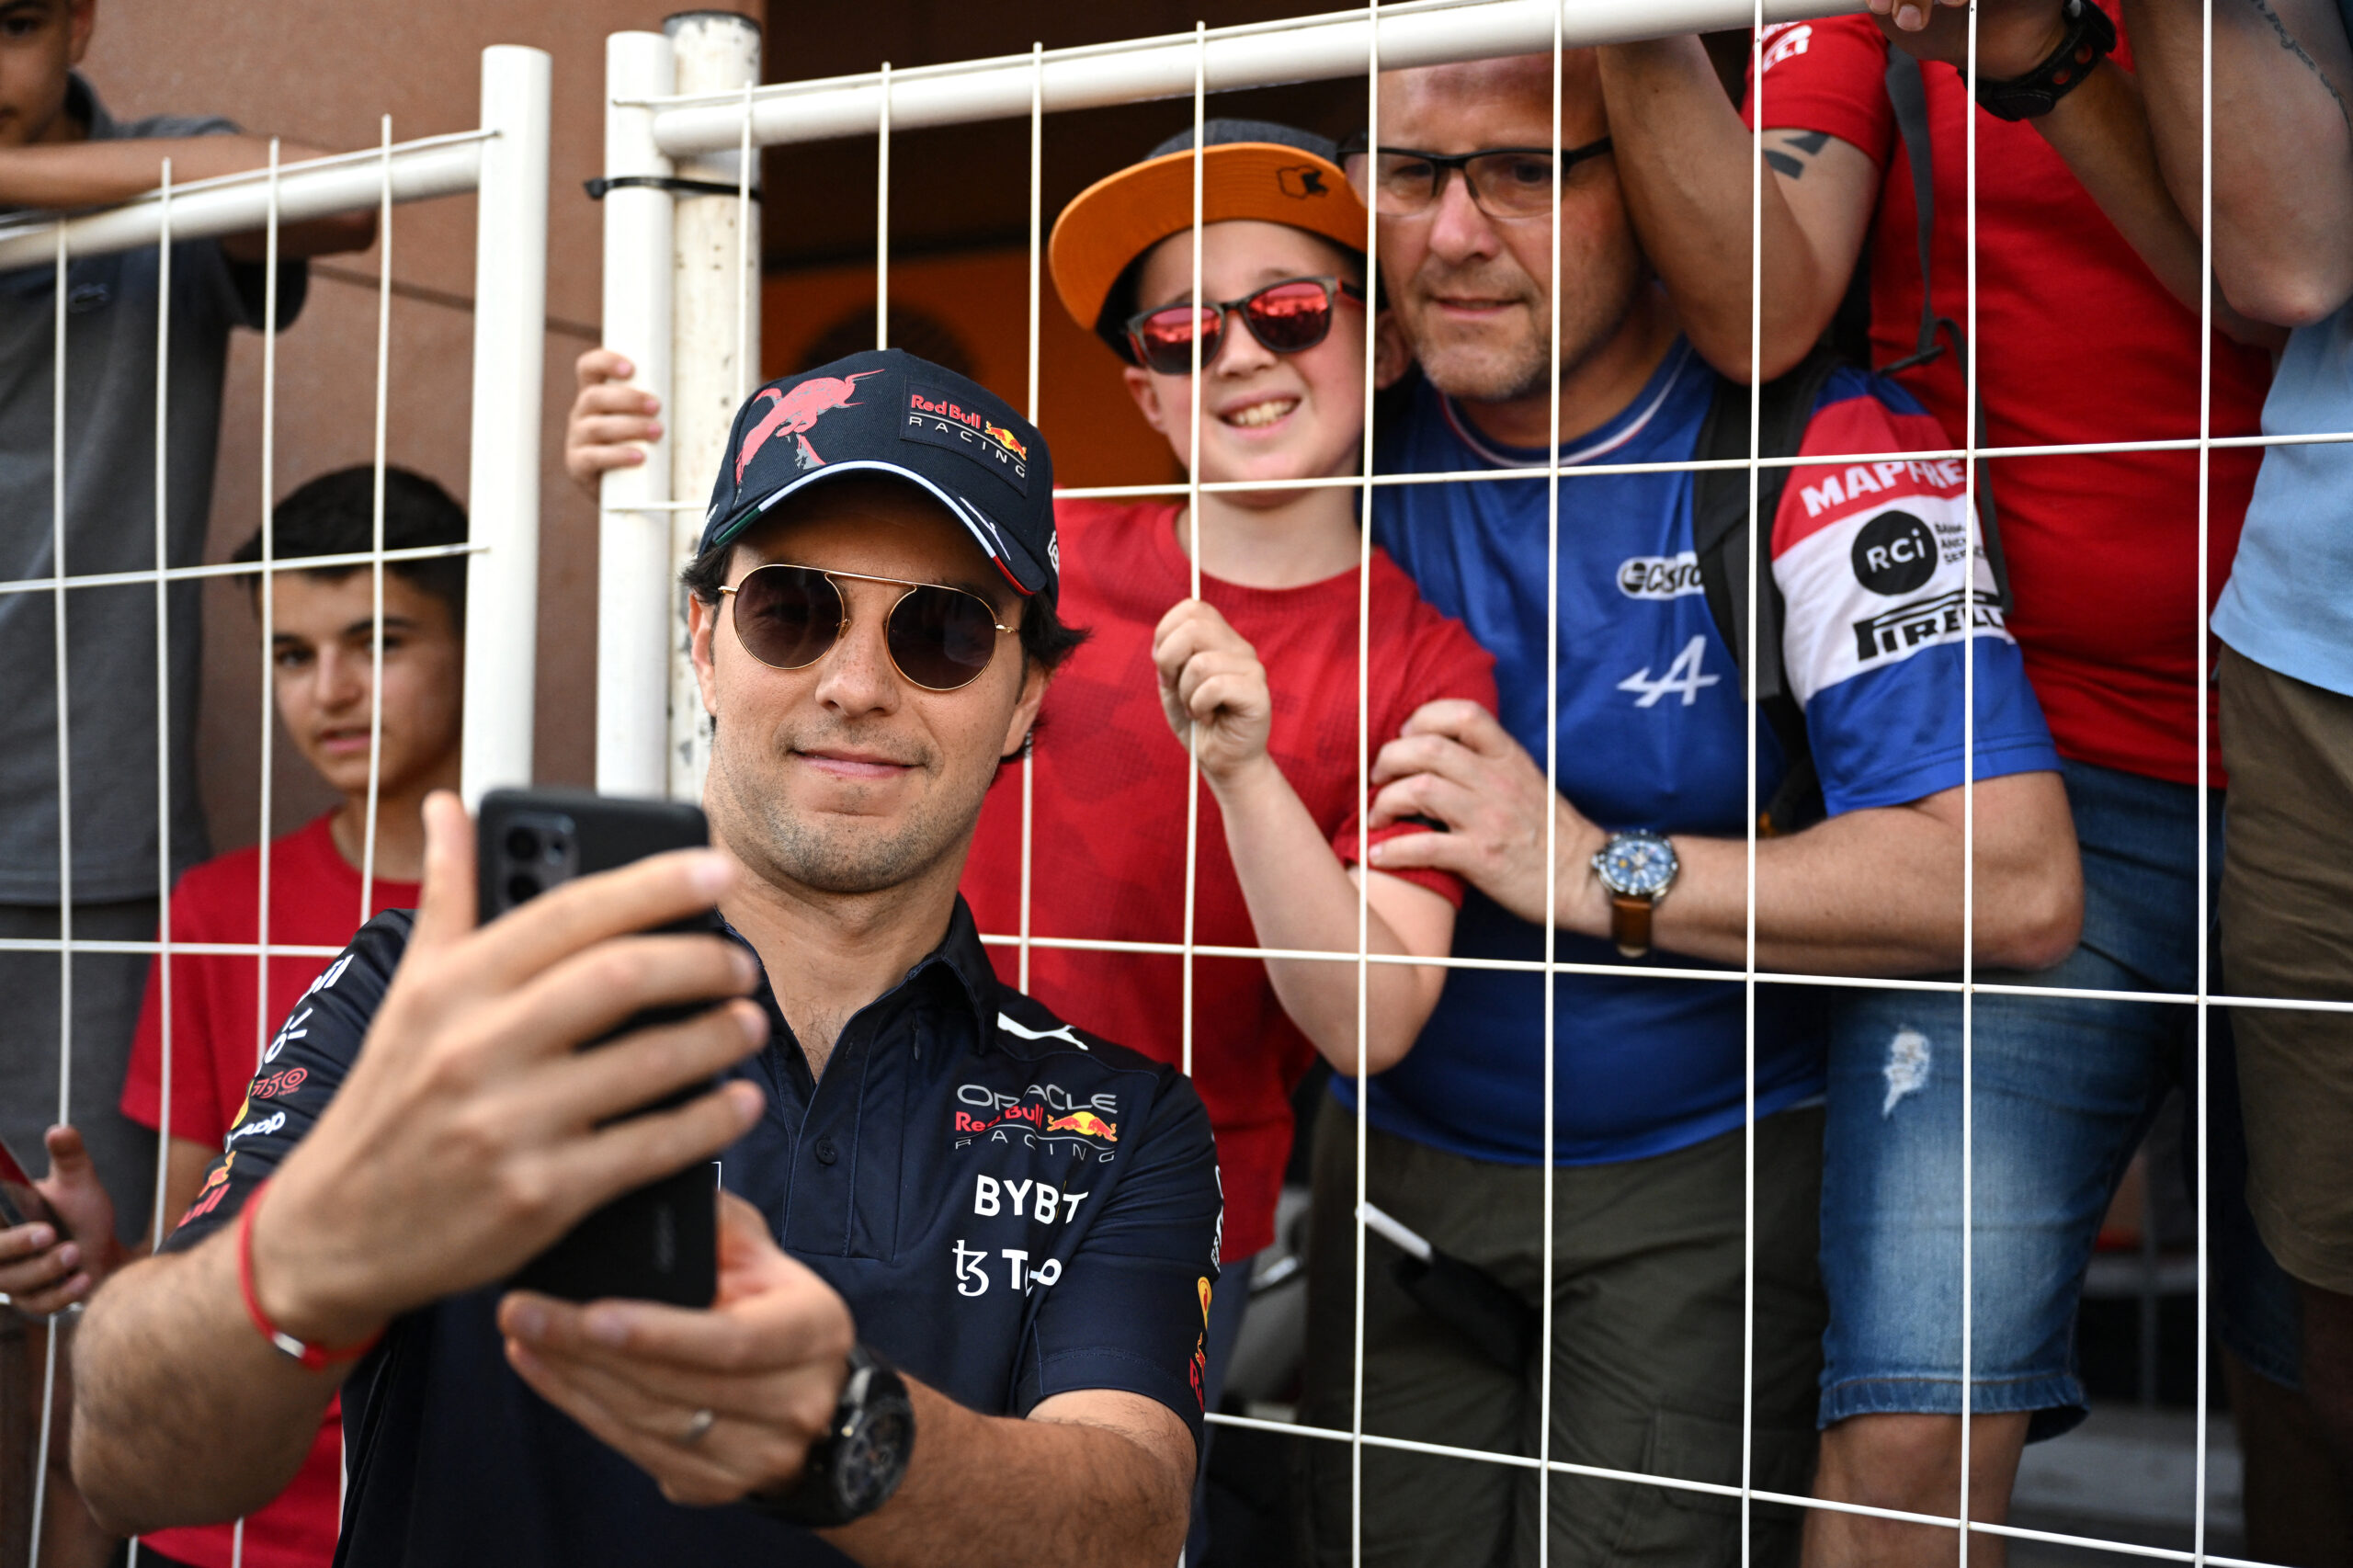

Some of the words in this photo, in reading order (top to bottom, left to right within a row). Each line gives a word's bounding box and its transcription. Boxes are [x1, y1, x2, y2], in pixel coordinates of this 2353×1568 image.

[911, 394, 948, 415] Red
[949, 403, 981, 429] Bull
[909, 415, 1025, 479] RACING
[957, 1084, 1118, 1114] ORACLE
[955, 1110, 1001, 1131] Red
[1005, 1103, 1043, 1130] Bull
[955, 1130, 1115, 1163] RACING
